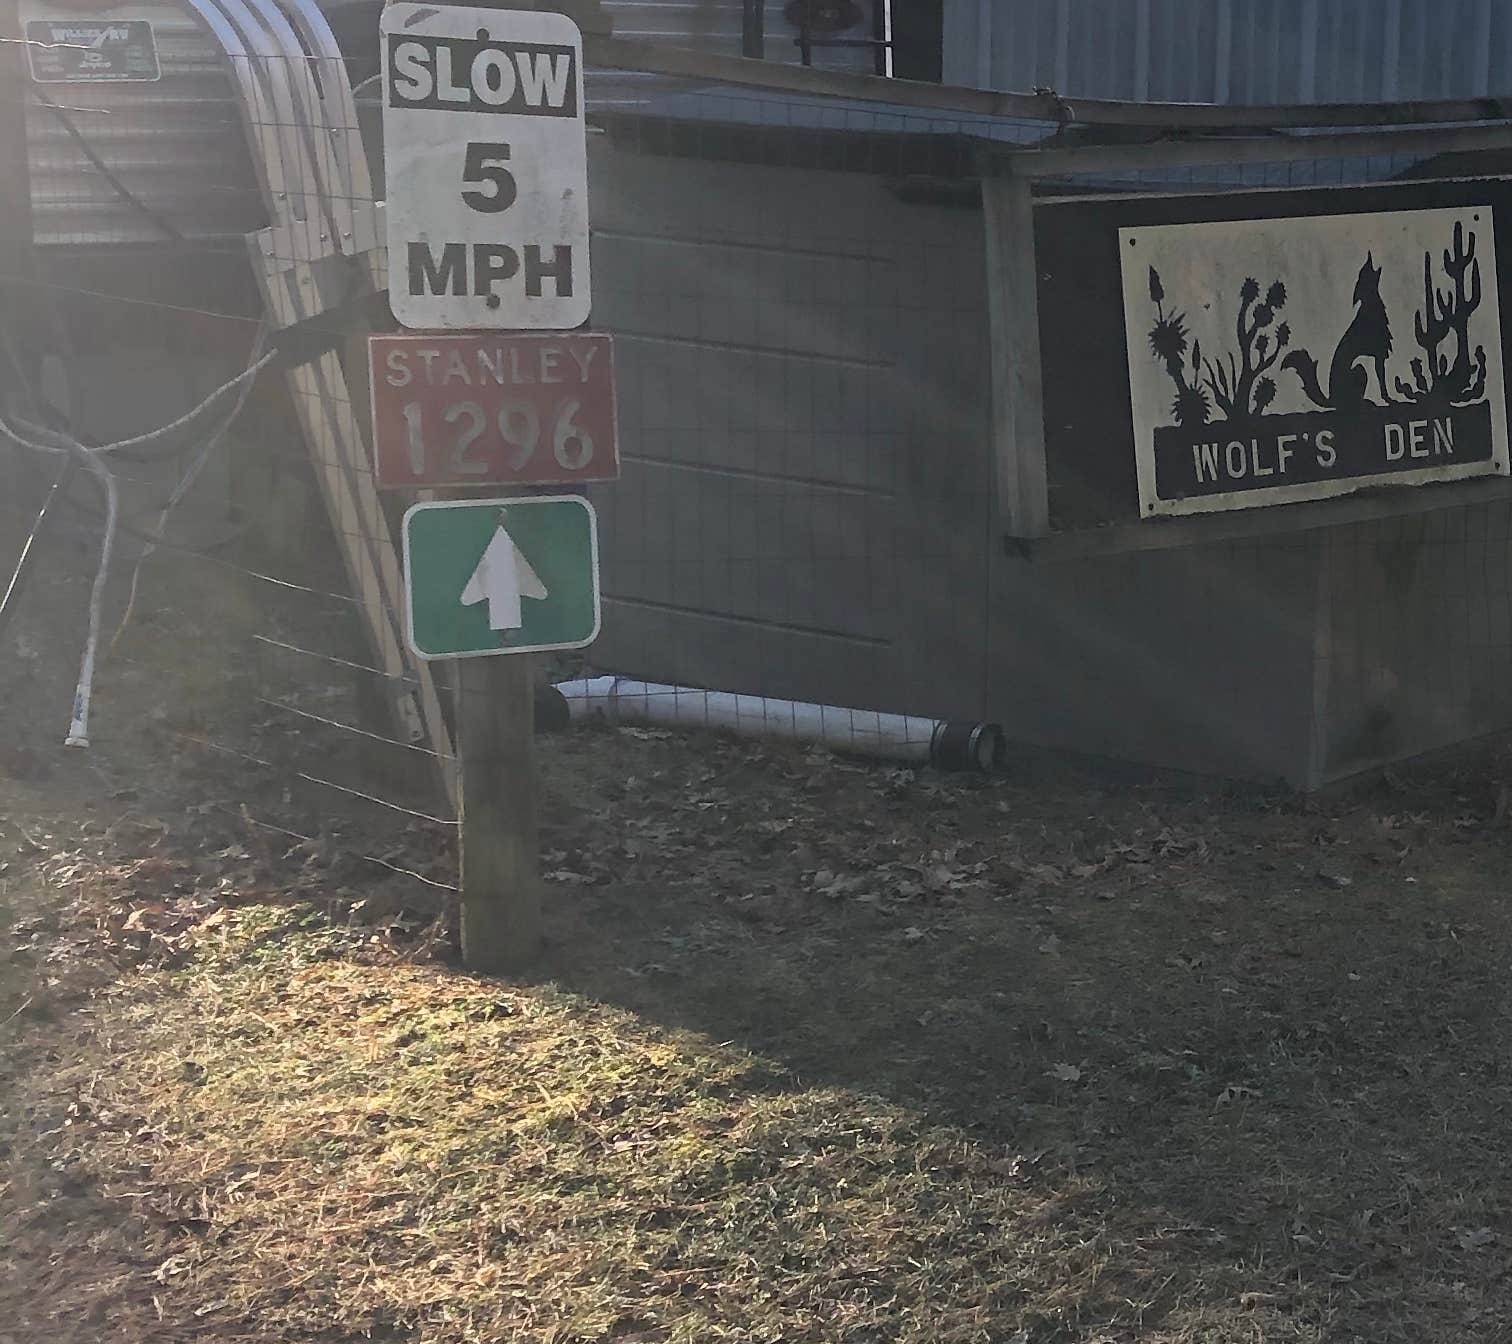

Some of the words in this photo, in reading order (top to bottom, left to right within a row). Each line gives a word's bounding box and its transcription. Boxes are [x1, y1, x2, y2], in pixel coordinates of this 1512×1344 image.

[393, 40, 570, 108] SLOW
[460, 142, 518, 214] 5
[406, 241, 574, 298] MPH
[385, 345, 599, 388] STANLEY
[402, 400, 595, 476] 1296
[1192, 430, 1337, 483] WOLF'S
[1384, 417, 1454, 461] DEN
